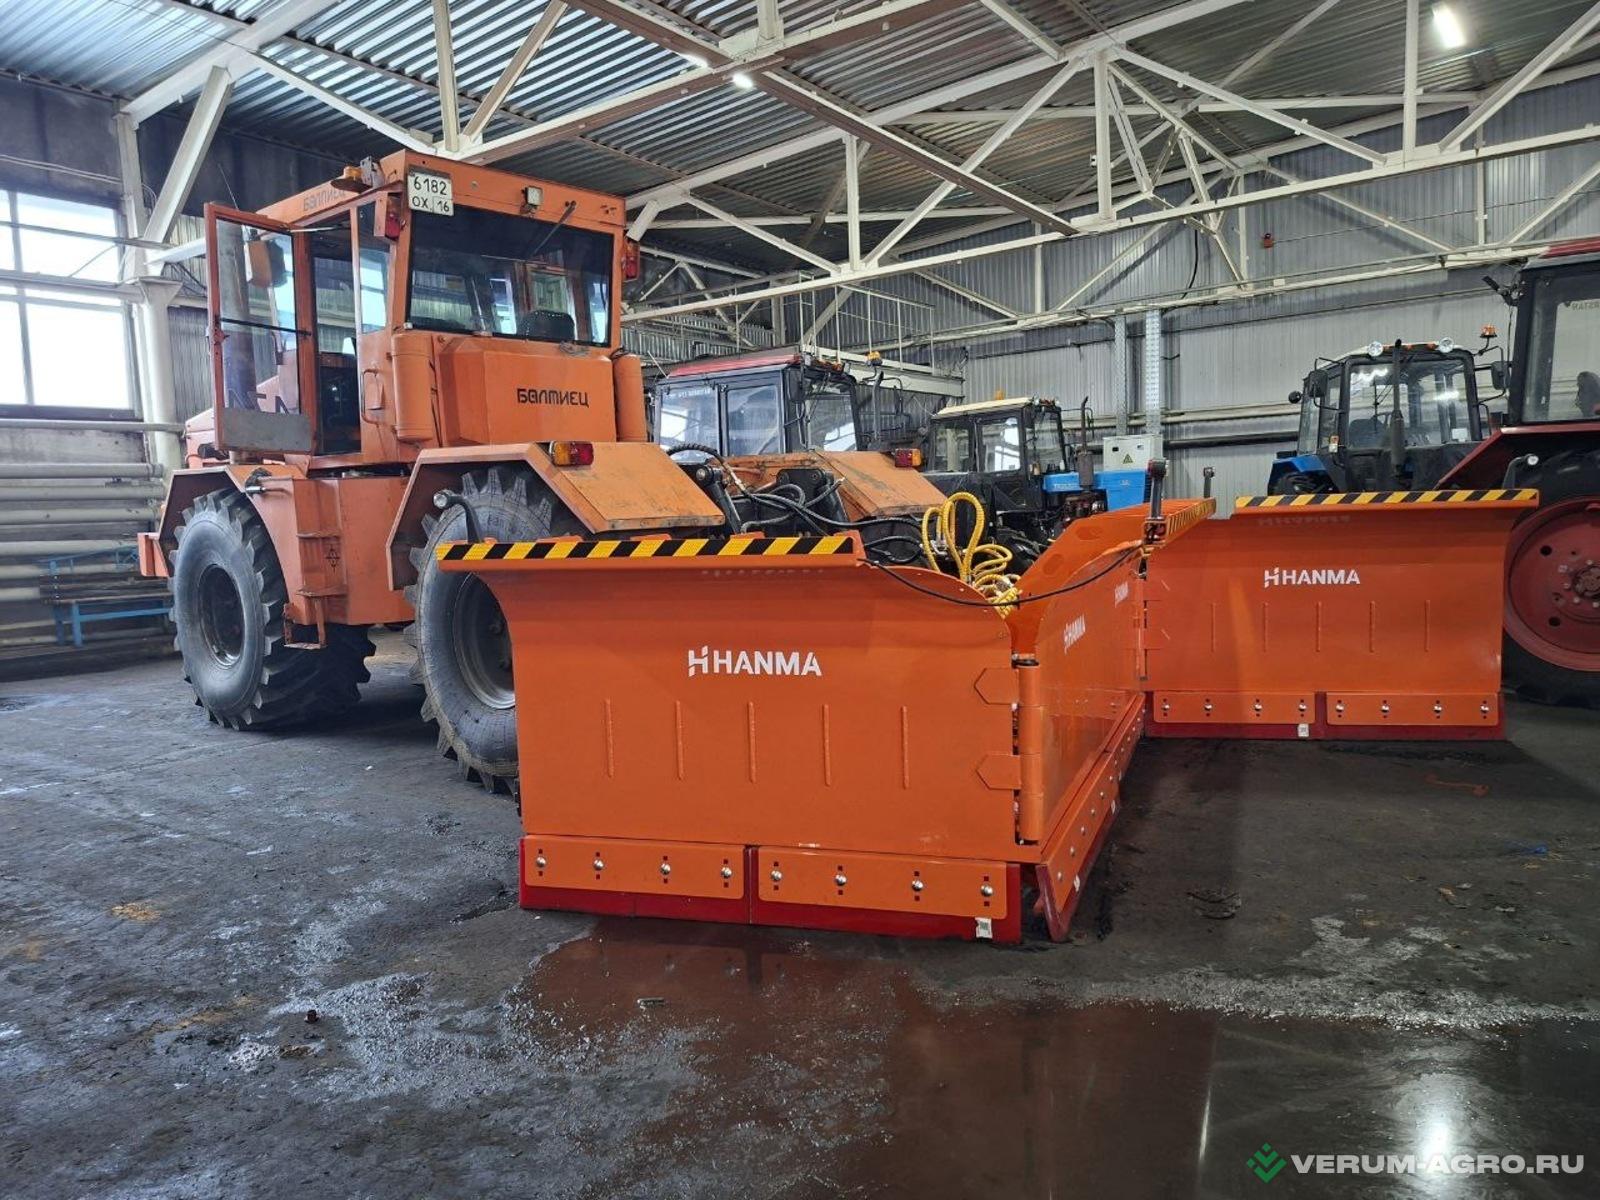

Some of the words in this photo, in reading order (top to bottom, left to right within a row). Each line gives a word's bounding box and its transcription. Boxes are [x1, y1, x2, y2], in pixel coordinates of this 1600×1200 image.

[413, 176, 448, 196] 6182
[437, 201, 450, 213] 16
[713, 650, 822, 677] HANMA
